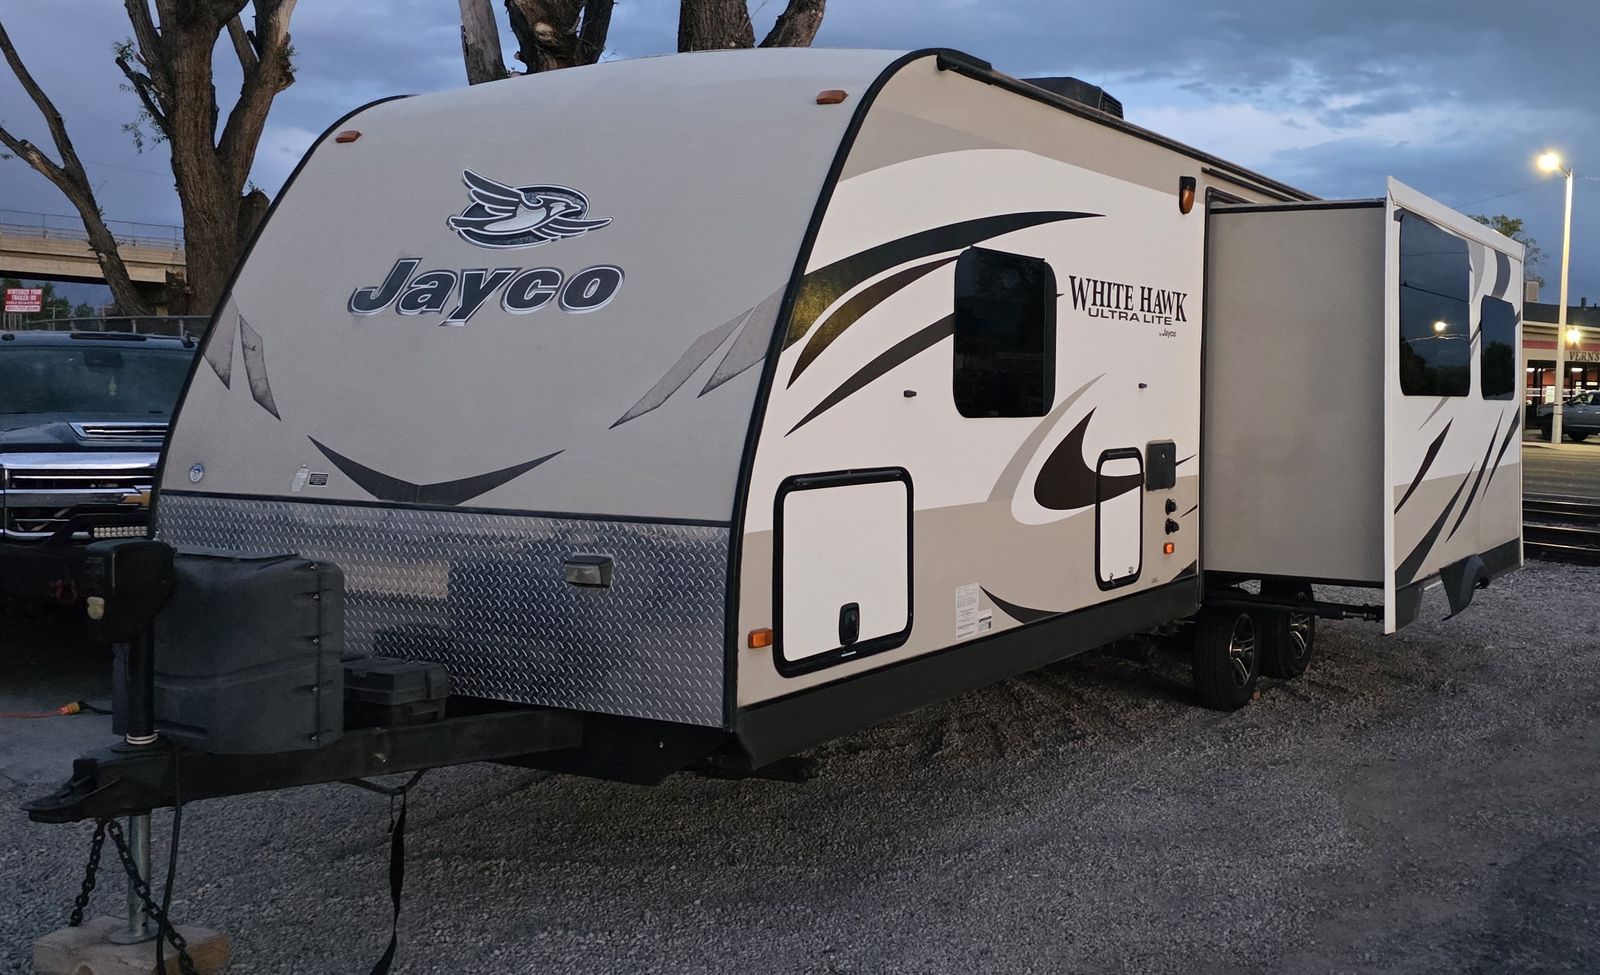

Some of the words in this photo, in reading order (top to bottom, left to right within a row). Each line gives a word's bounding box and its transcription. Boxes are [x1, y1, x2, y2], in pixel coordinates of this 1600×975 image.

[347, 257, 625, 327] Jayco
[1068, 275, 1134, 311] WHITE
[1140, 286, 1188, 322] HAWK
[1088, 307, 1140, 322] ULTRA
[1143, 314, 1172, 326] LITE
